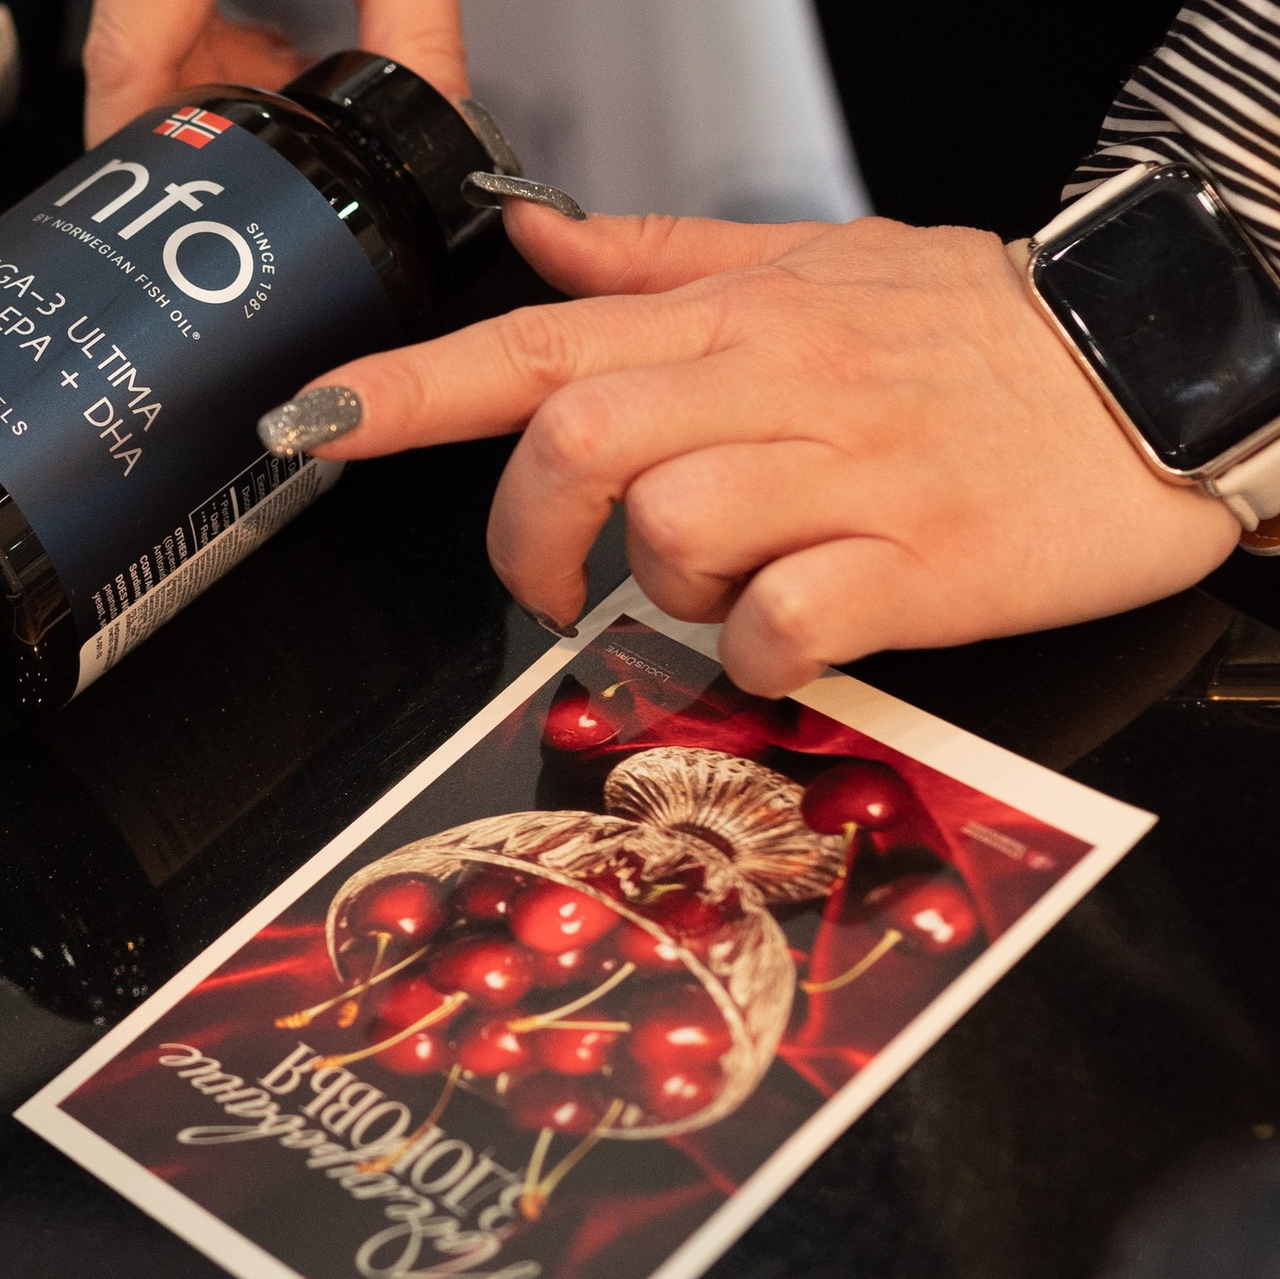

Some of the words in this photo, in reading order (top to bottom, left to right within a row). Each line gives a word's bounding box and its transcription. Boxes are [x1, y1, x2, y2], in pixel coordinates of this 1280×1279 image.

[32, 213, 54, 225] BY
[51, 218, 136, 275] NORWEGIAN
[135, 274, 171, 308] FISH
[53, 158, 254, 304] nfo
[246, 222, 275, 275] SINCE
[244, 283, 272, 319] 1987
[67, 315, 162, 432] ULTIMA
[60, 370, 79, 389] +
[83, 396, 142, 477] DHA
[115, 573, 128, 601] DOES
[174, 526, 188, 560] OTHER
[257, 1041, 528, 1233] ЗДОРОВЬЯ
